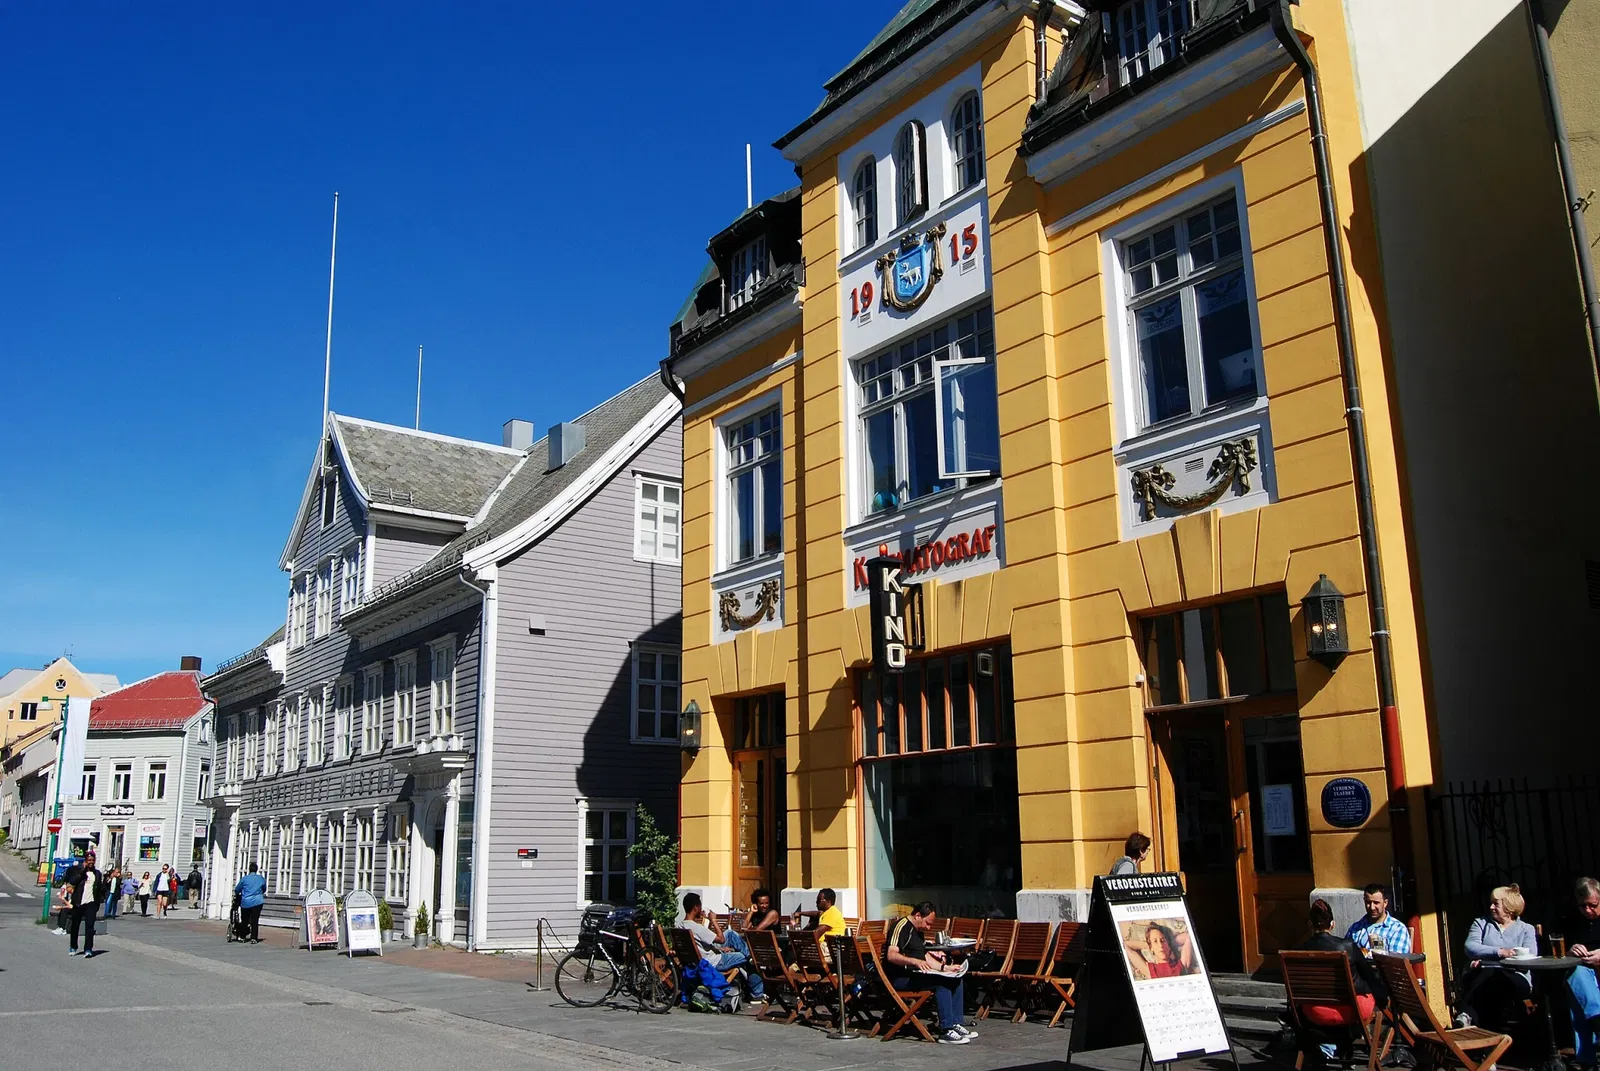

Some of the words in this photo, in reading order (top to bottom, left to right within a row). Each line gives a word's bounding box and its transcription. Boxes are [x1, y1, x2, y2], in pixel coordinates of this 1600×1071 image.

[850, 281, 874, 316] 19
[951, 223, 978, 262] 15
[853, 524, 997, 589] KMATOGRAF
[882, 567, 906, 668] KINO
[340, 766, 395, 799] MUSEUM
[1105, 876, 1178, 890] VERDENSTEATRET
[1126, 904, 1169, 912] VERDENSTEATRET
